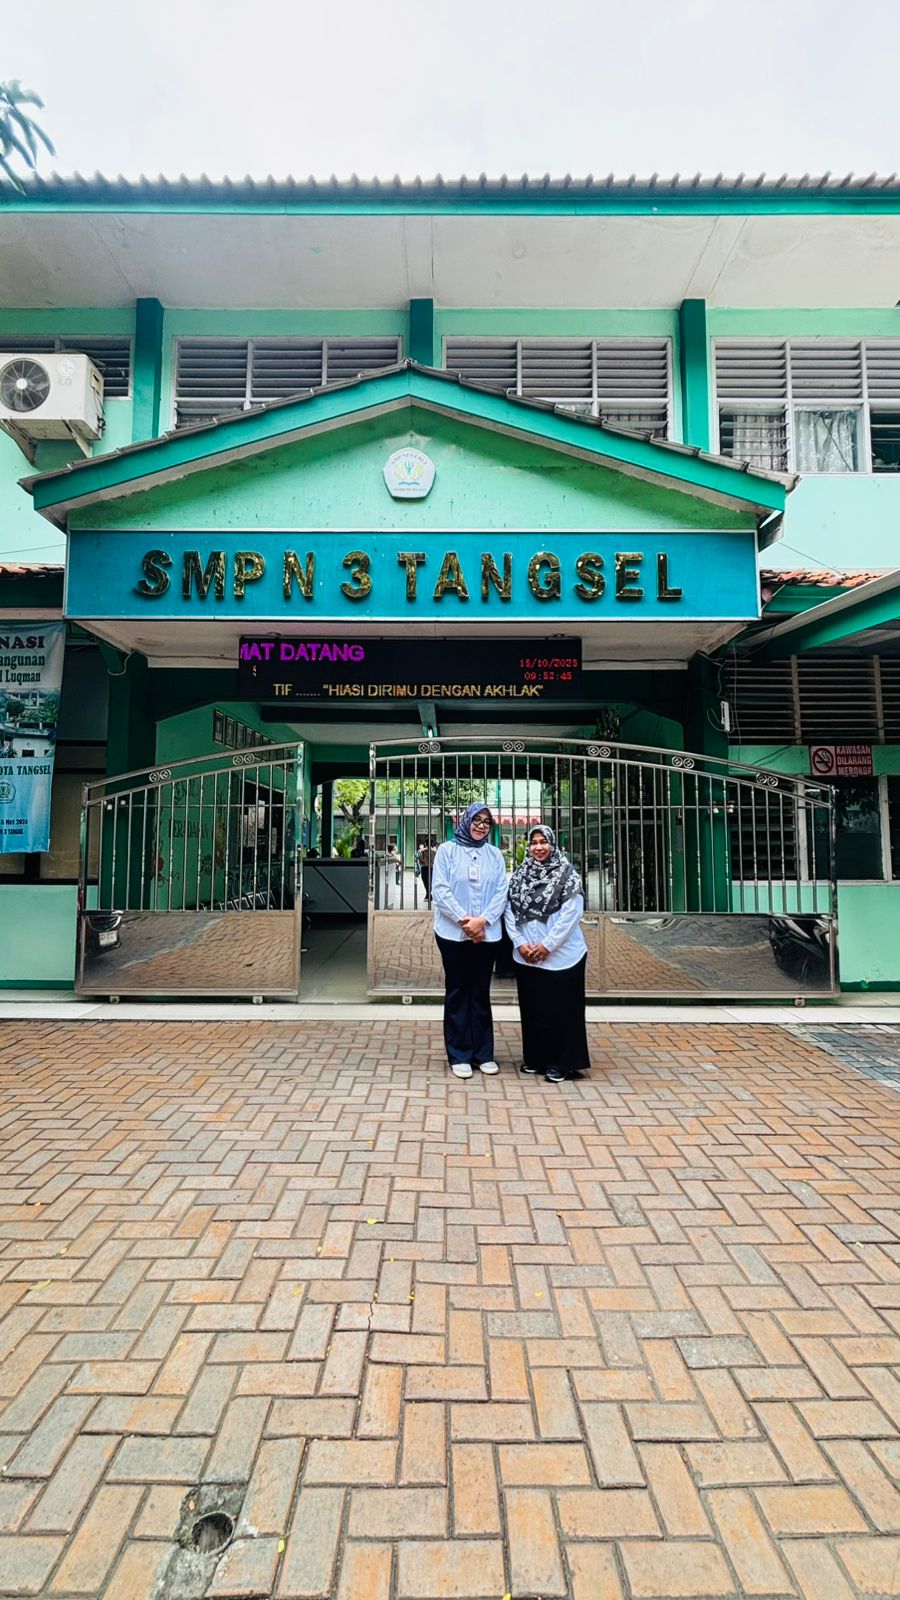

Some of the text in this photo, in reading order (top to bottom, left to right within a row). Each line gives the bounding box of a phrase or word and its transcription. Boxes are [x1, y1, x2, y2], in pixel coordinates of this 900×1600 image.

[135, 550, 684, 600] SMP N 3 TANGSEL
[280, 643, 365, 661] DATANG
[520, 659, 578, 668] 15/10/2025
[5, 670, 41, 686] Luqman
[273, 684, 293, 696] TIF
[368, 685, 417, 697] DIRIMU
[421, 685, 480, 697] DENGAN
[836, 745, 871, 754] KAWASAN
[837, 755, 872, 765] DILARANG
[17, 765, 51, 775] TANGSEL
[838, 766, 872, 775] MEROKOK
